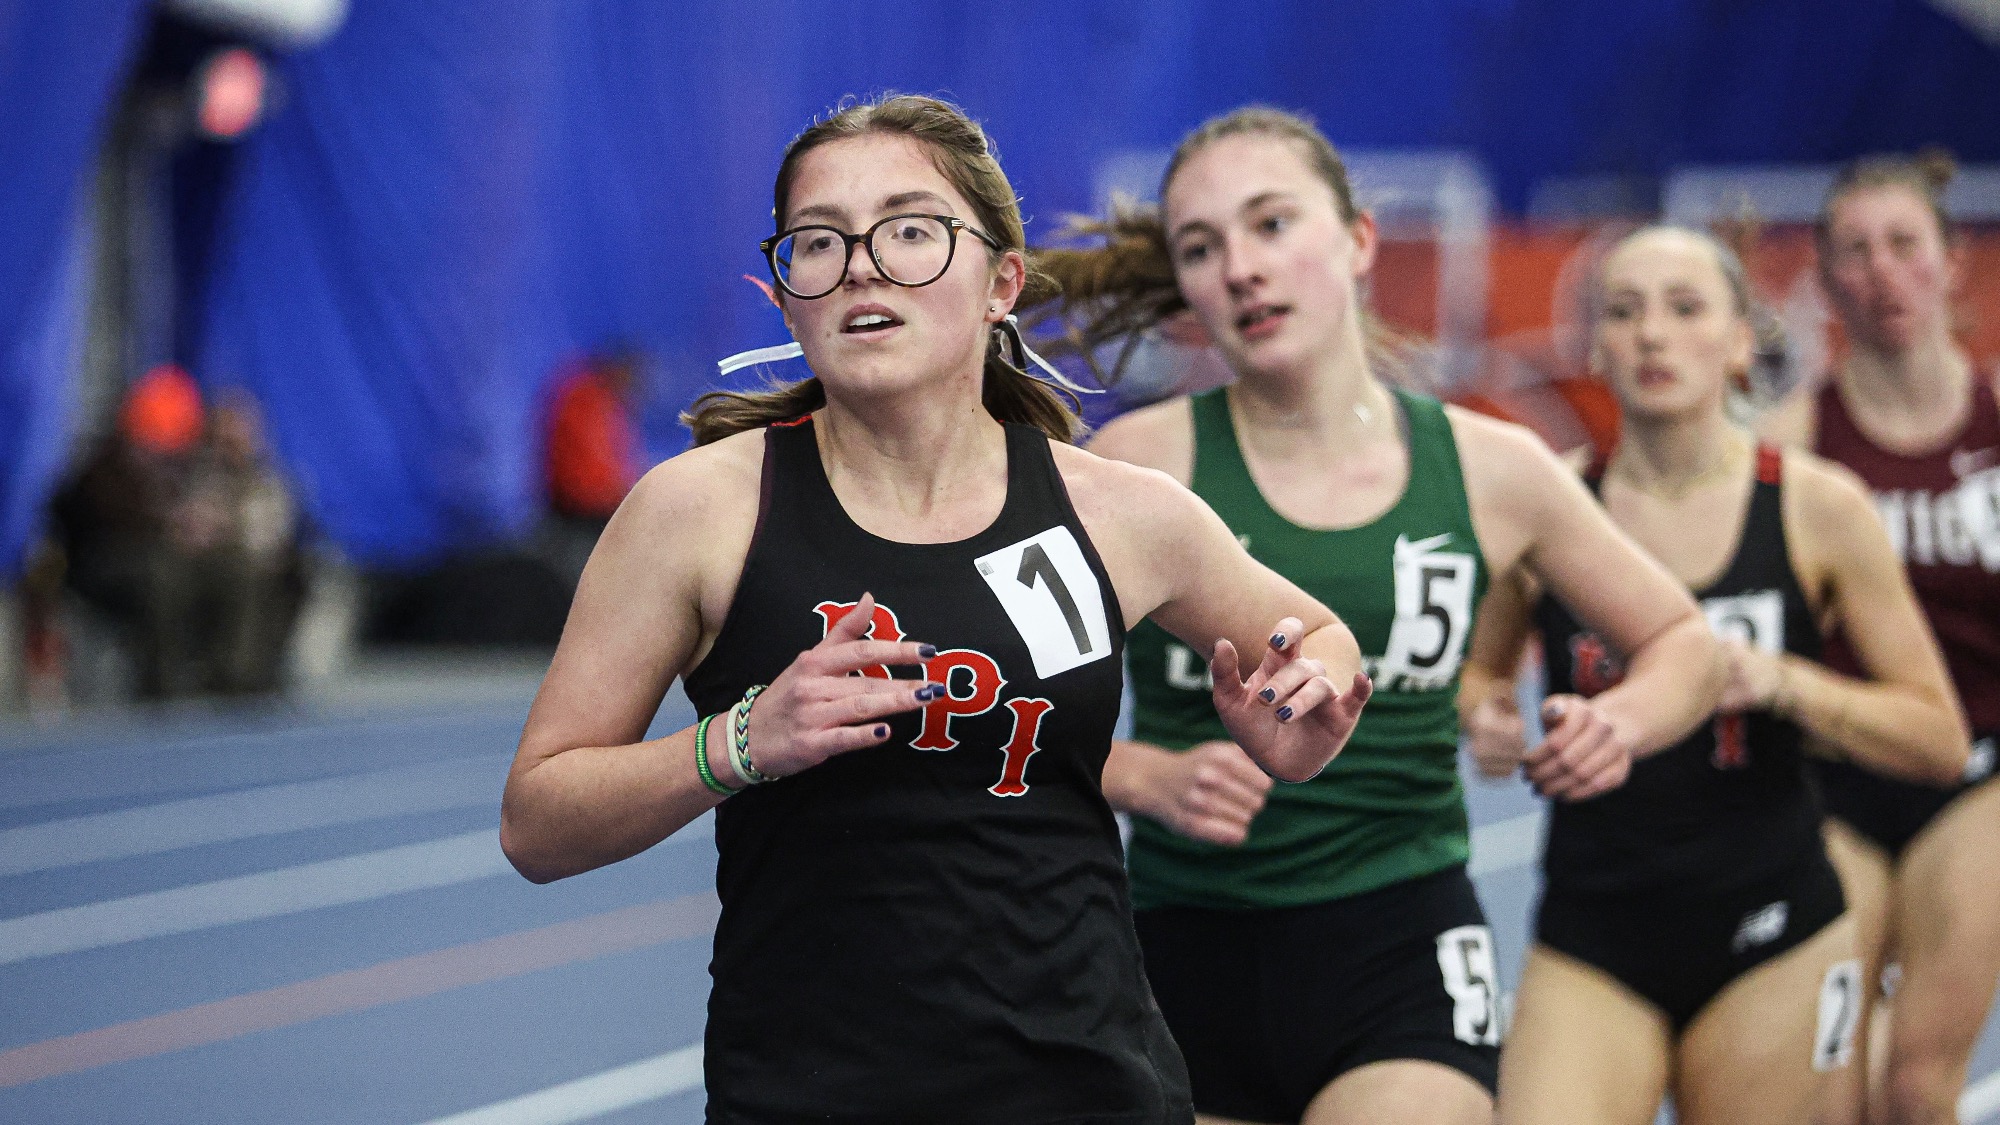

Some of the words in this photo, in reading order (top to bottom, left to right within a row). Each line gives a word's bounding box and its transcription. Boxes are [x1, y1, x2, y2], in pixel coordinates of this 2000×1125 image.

[1016, 542, 1093, 656] 1
[1410, 566, 1456, 669] 5
[1457, 938, 1491, 1037] 5
